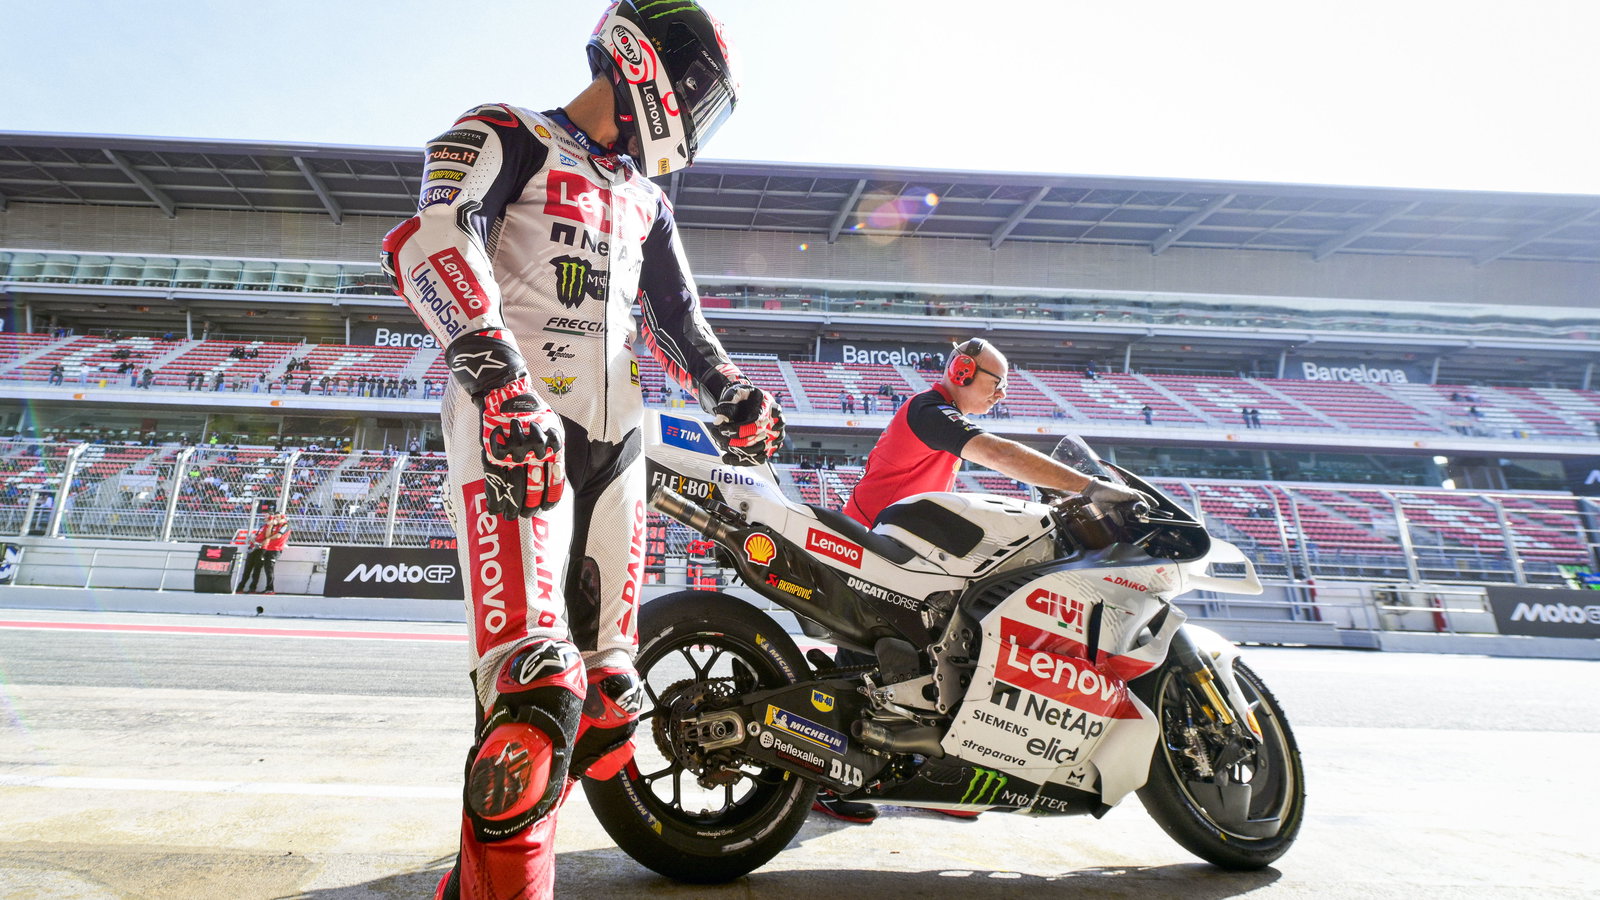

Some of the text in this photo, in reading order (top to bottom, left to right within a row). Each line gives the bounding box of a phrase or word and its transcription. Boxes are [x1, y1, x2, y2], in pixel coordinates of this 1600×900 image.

[615, 26, 639, 63] SUOMY
[643, 85, 663, 135] Lenovo
[574, 131, 590, 149] TIM
[427, 147, 476, 163] ruba.it
[438, 254, 482, 310] Lenovo
[412, 262, 467, 339] UnipolSai
[374, 328, 441, 348] Barce
[1302, 362, 1408, 384] Barcelona
[680, 429, 700, 443] TIM
[652, 471, 716, 500] FLEX-BOX
[711, 469, 754, 485] riello
[621, 499, 645, 606] DAIKO
[811, 533, 859, 561] Lenovo
[344, 563, 455, 583] MotoGP
[475, 492, 507, 634] Lenovo
[1113, 577, 1148, 592] DAIKO
[1026, 588, 1085, 628] GIVI
[1510, 602, 1600, 624] MotoG
[769, 649, 796, 684] MICHEL
[973, 710, 1029, 737] SIEMENS
[1024, 694, 1104, 740] NetAp
[790, 721, 842, 748] MICHELIN
[774, 738, 825, 768] Reflexallen
[962, 738, 1027, 767] streparava
[620, 769, 648, 815] MICHELI
